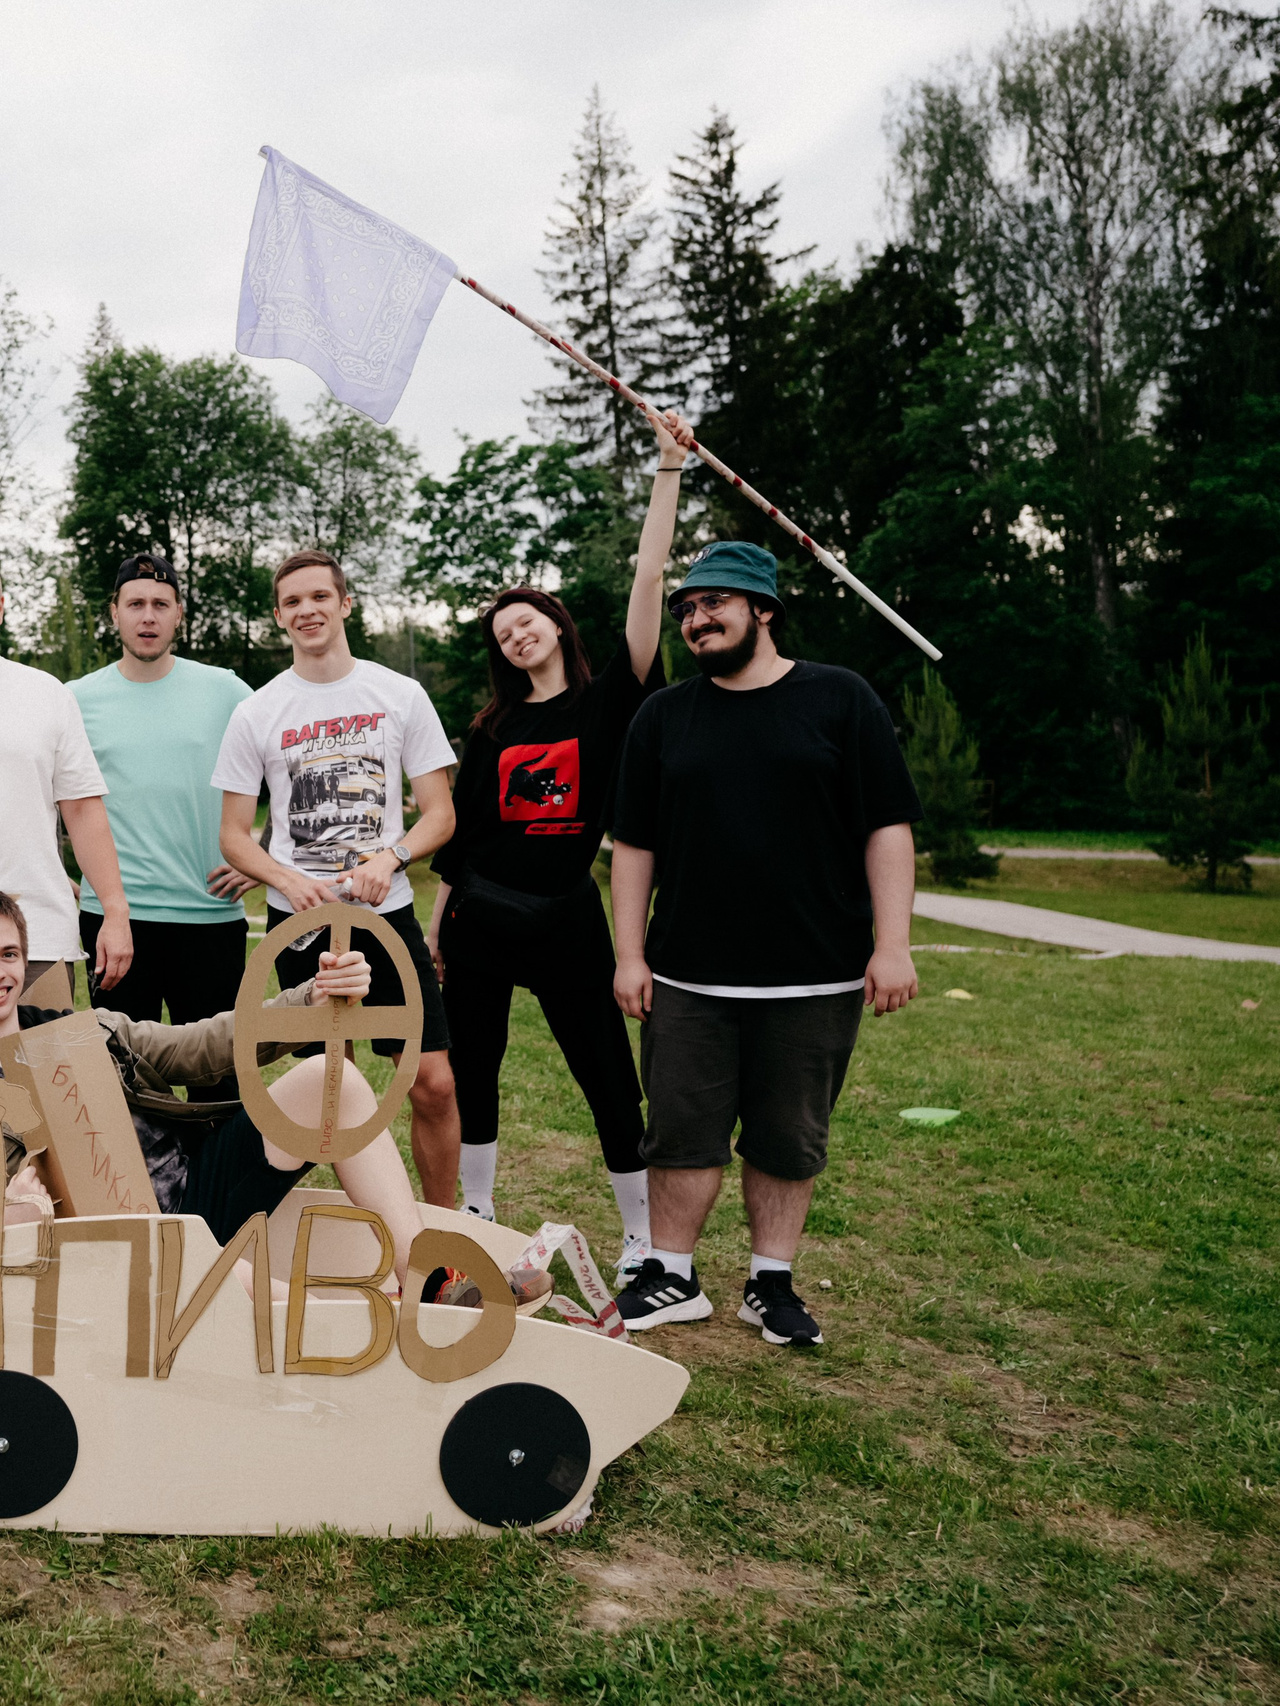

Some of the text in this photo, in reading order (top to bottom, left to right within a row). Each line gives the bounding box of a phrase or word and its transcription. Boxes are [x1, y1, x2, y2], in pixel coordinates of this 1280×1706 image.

[281, 713, 386, 751] ВАГБУРГ
[302, 731, 366, 754] И ТОЧКА
[33, 1204, 516, 1382] ПИВО
